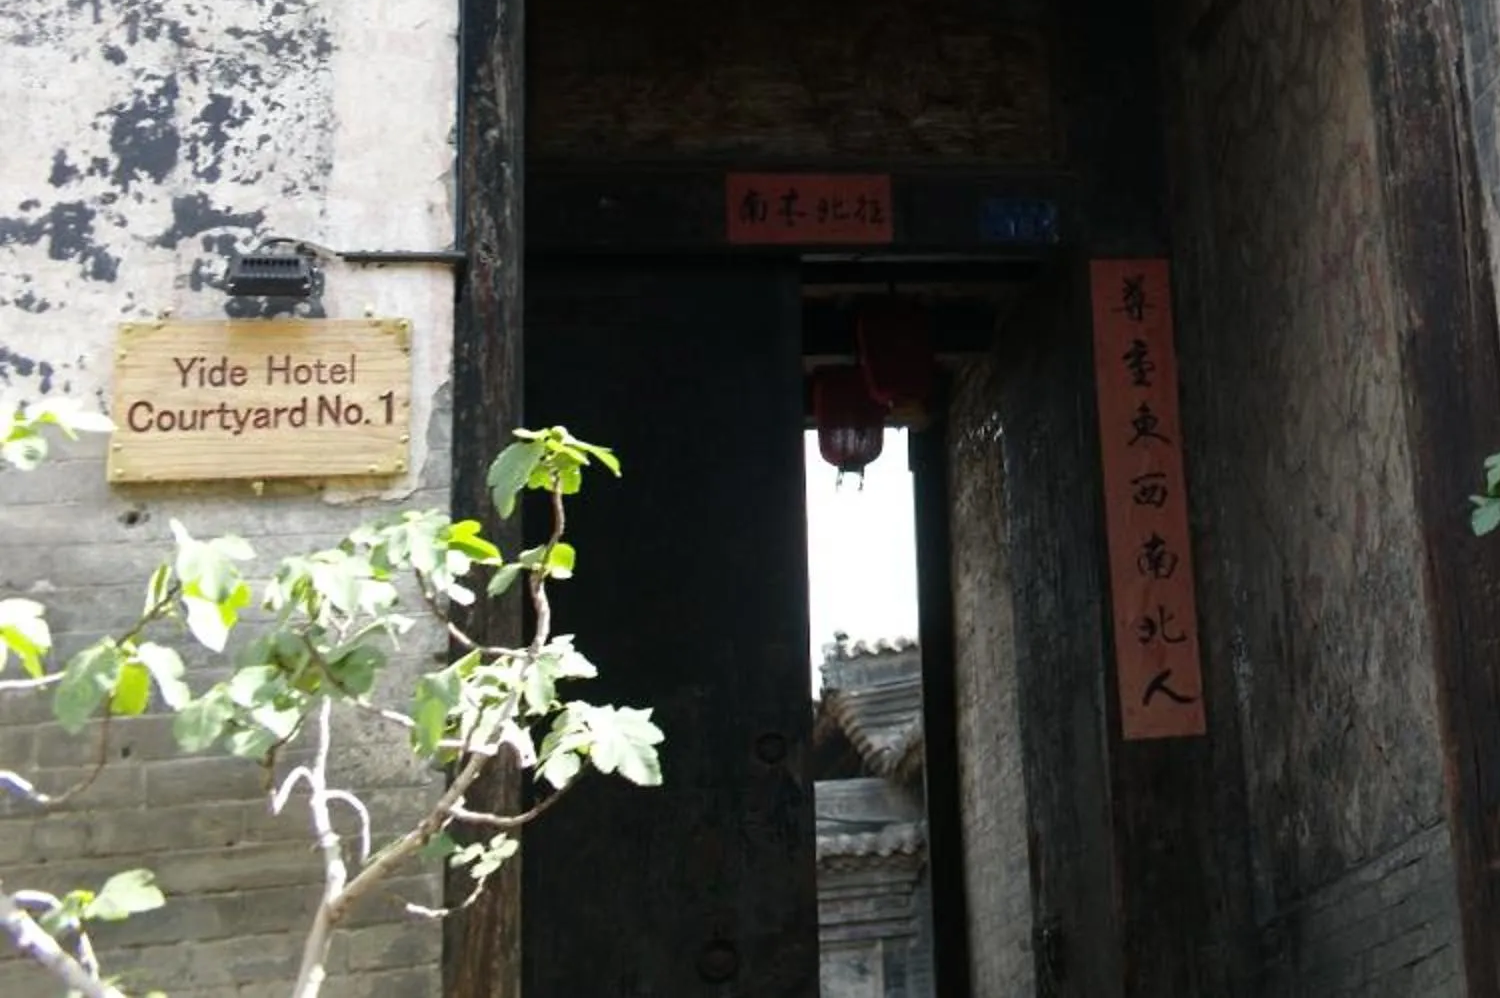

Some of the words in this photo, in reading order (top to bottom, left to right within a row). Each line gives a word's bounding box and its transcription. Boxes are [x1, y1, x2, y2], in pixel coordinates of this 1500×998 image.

[173, 355, 249, 388] Yide
[266, 353, 357, 386] Hotel
[127, 397, 308, 436] Courtyard
